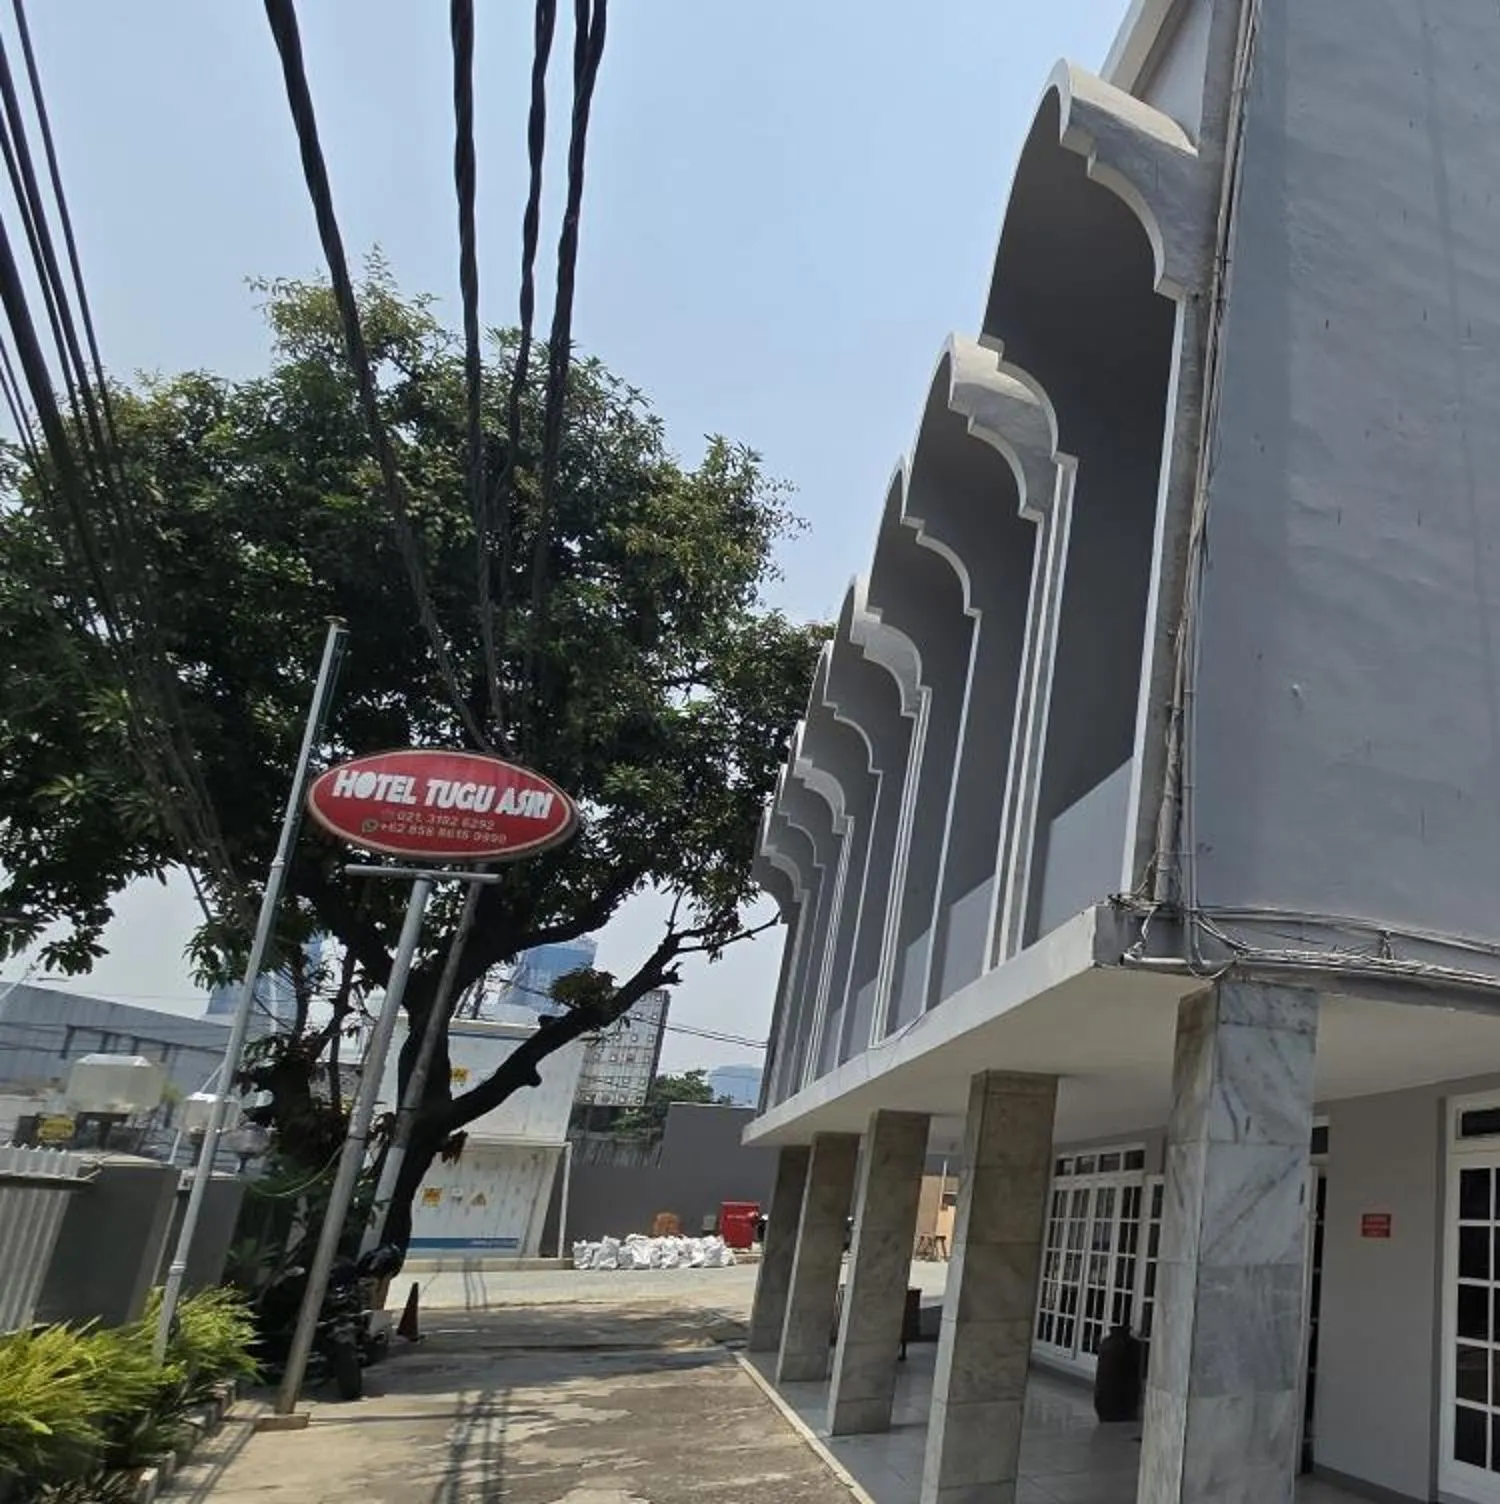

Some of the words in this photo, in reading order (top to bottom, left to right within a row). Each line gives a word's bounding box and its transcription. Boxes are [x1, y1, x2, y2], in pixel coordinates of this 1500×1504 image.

[332, 770, 417, 805] HOTEL
[424, 779, 496, 813] TUGU
[494, 787, 554, 819] ASRI
